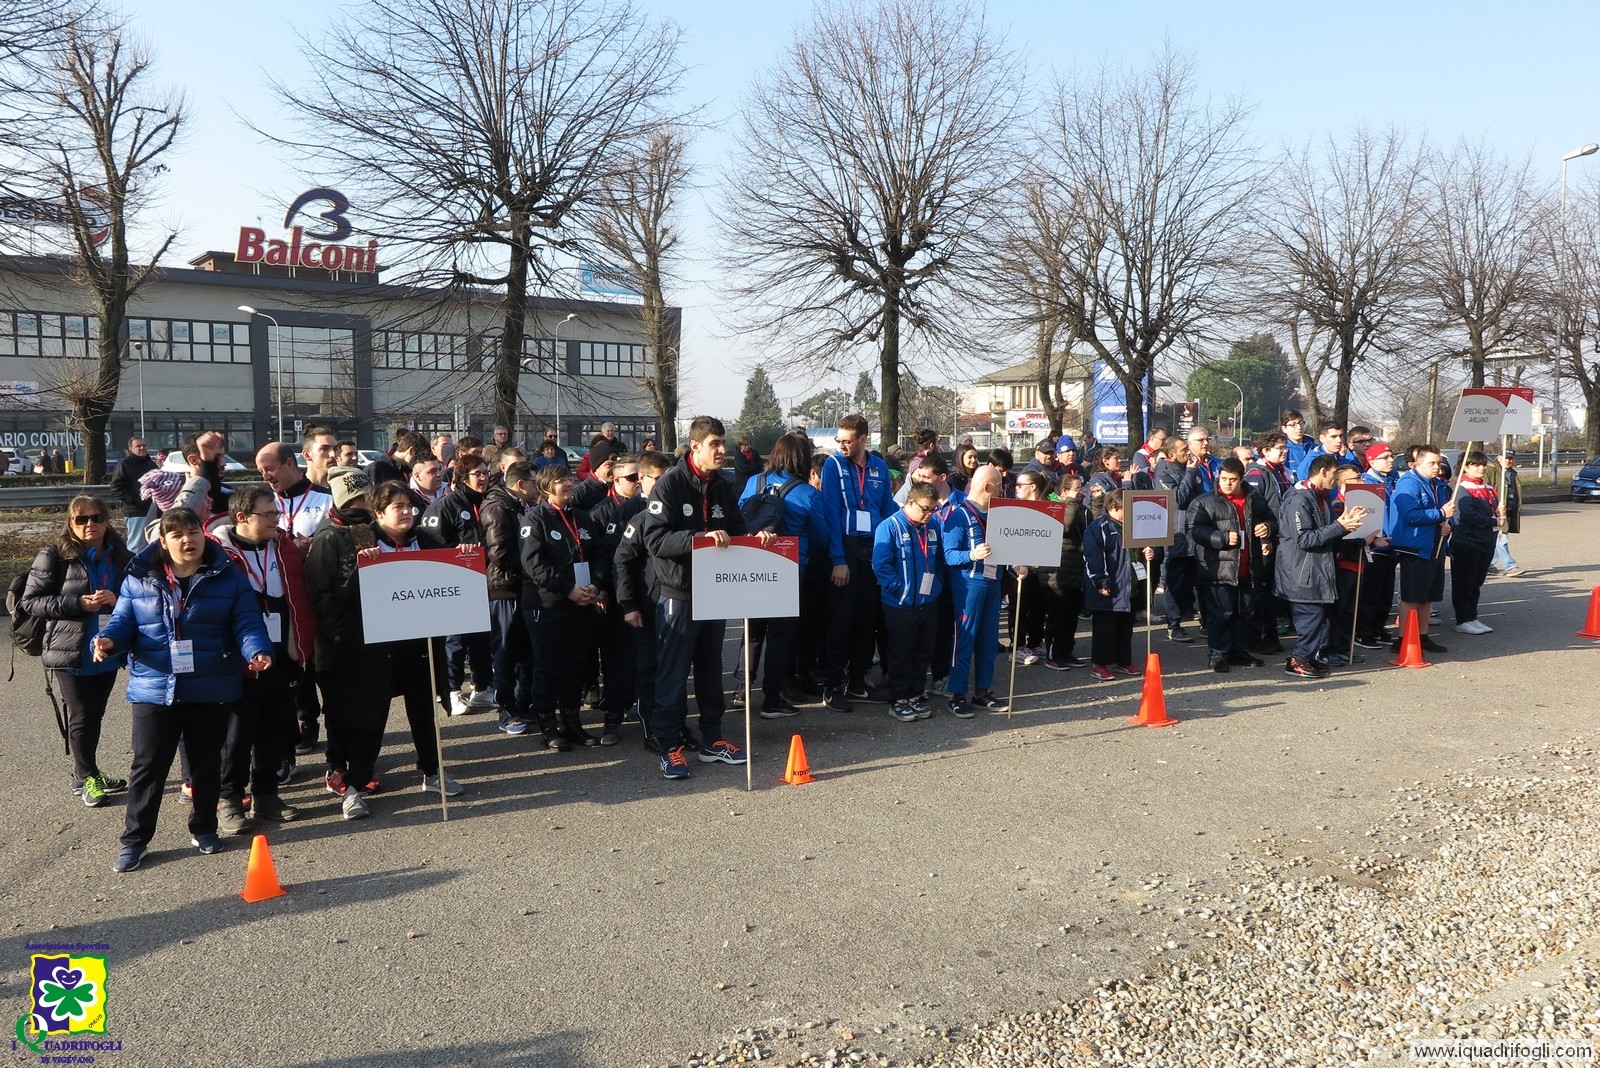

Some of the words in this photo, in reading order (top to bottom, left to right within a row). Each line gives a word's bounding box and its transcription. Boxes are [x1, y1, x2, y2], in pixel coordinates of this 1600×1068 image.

[234, 226, 378, 273] Balconi
[1003, 527, 1052, 538] QUADRIFOGLI
[715, 573, 748, 582] BRIXIA
[749, 572, 778, 582] SMILE
[391, 590, 415, 601] ASA
[417, 586, 461, 599] VARESE
